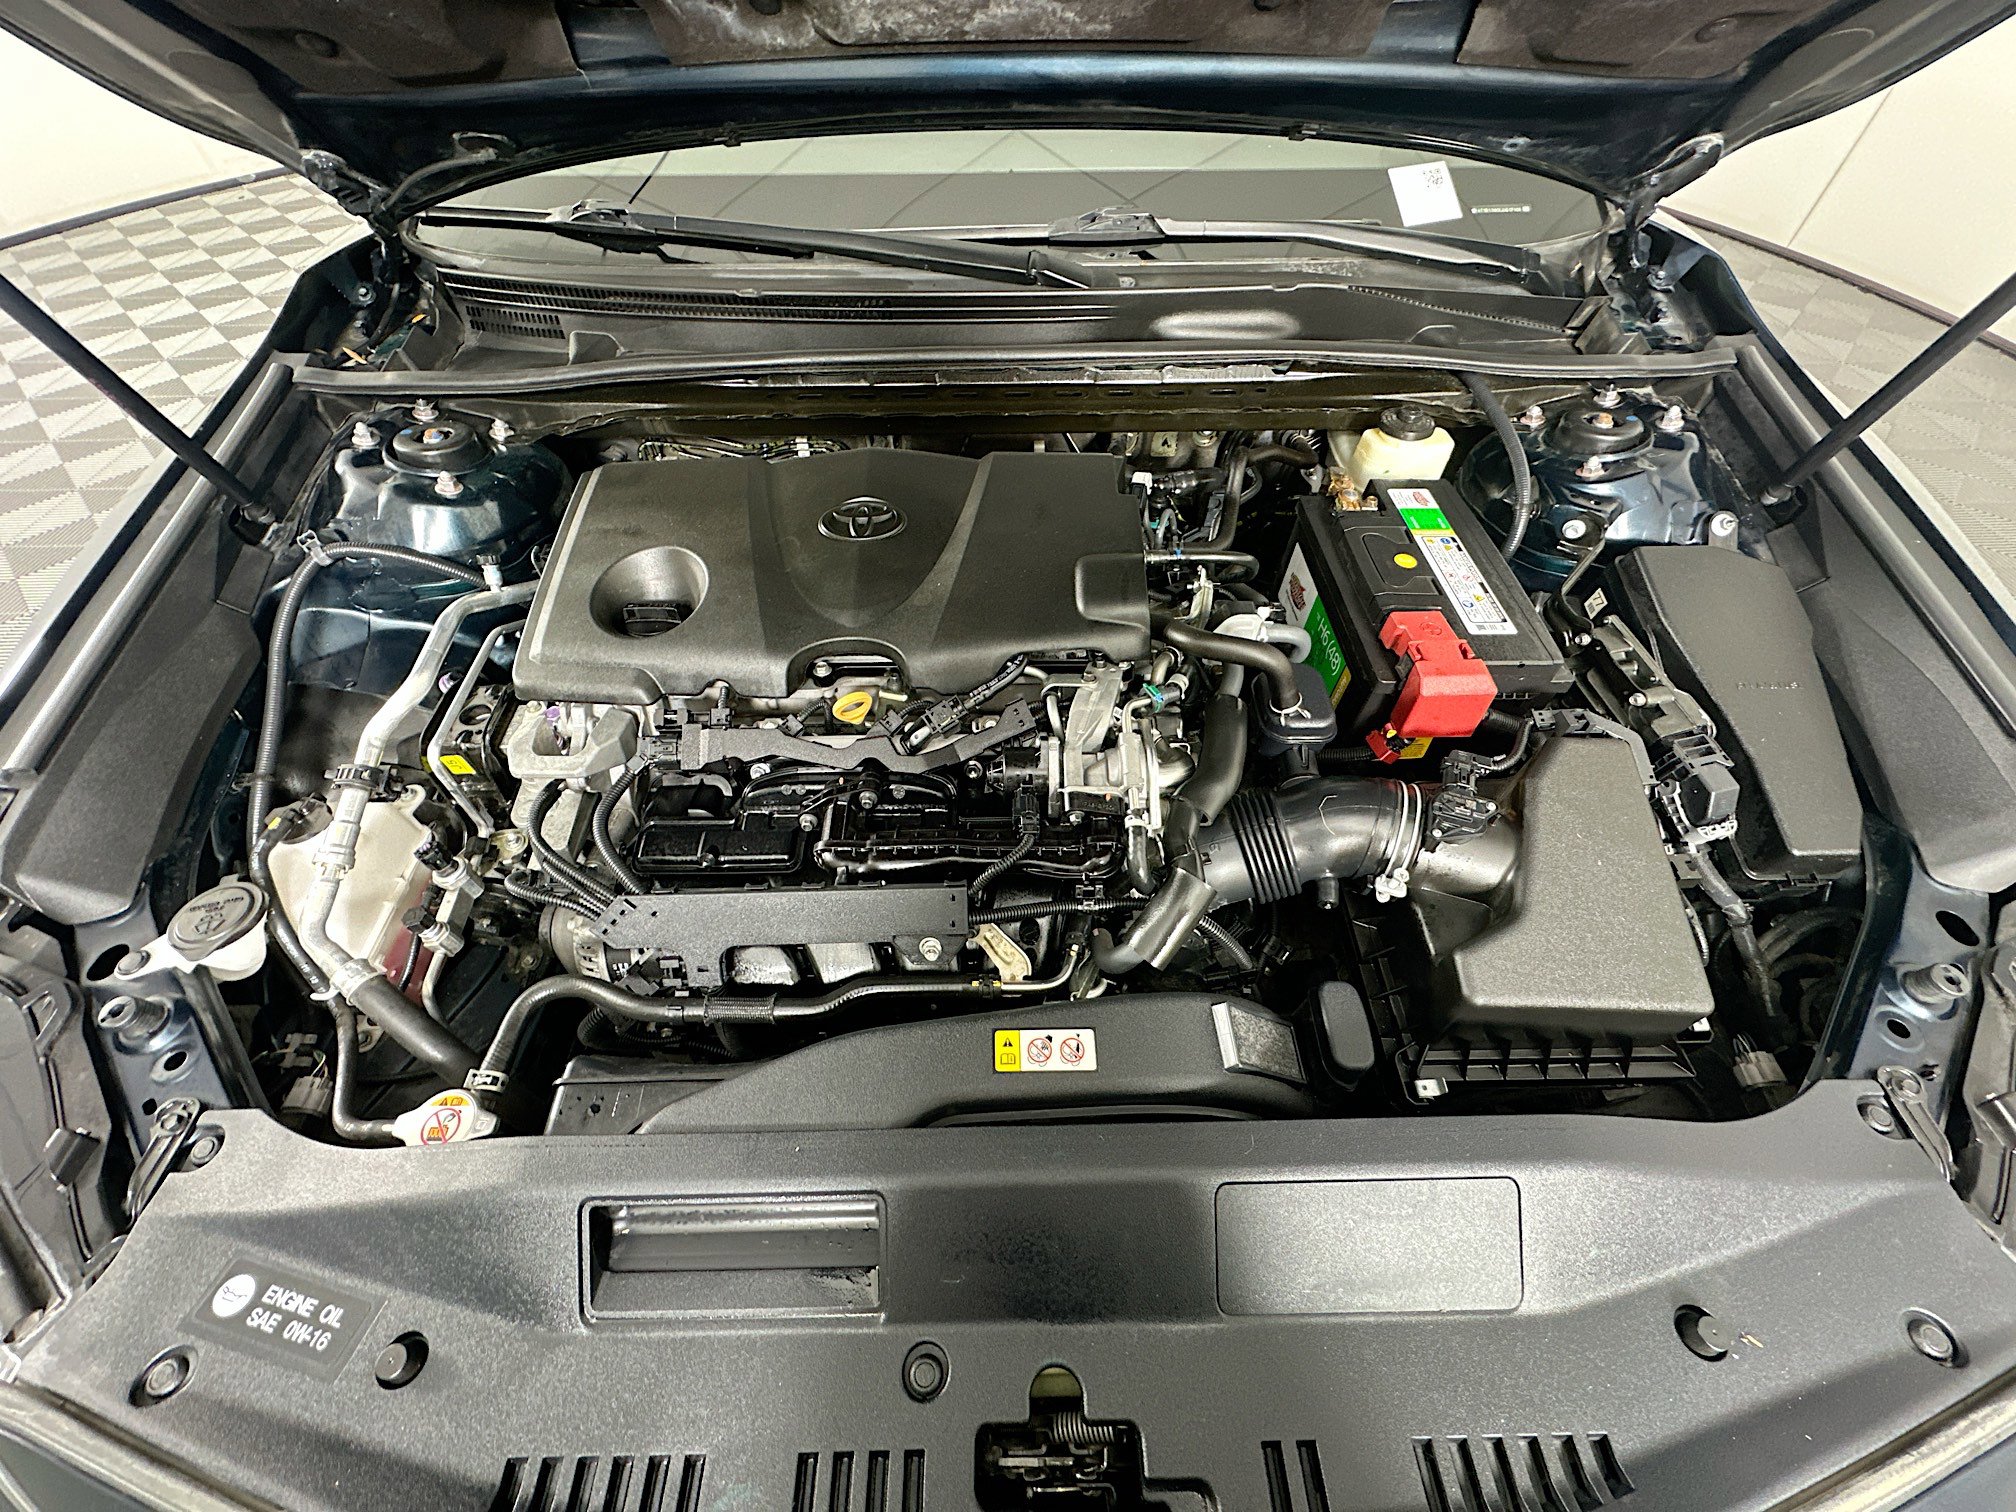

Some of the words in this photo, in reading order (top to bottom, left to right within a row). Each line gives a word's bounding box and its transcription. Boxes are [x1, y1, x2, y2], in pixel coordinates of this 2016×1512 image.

[1318, 617, 1331, 646] H6
[1325, 640, 1341, 676] (48)
[246, 1307, 282, 1334] SAE
[283, 1320, 332, 1351] 0W-16
[261, 1284, 319, 1318] ENGINE
[319, 1304, 344, 1329] OIL
